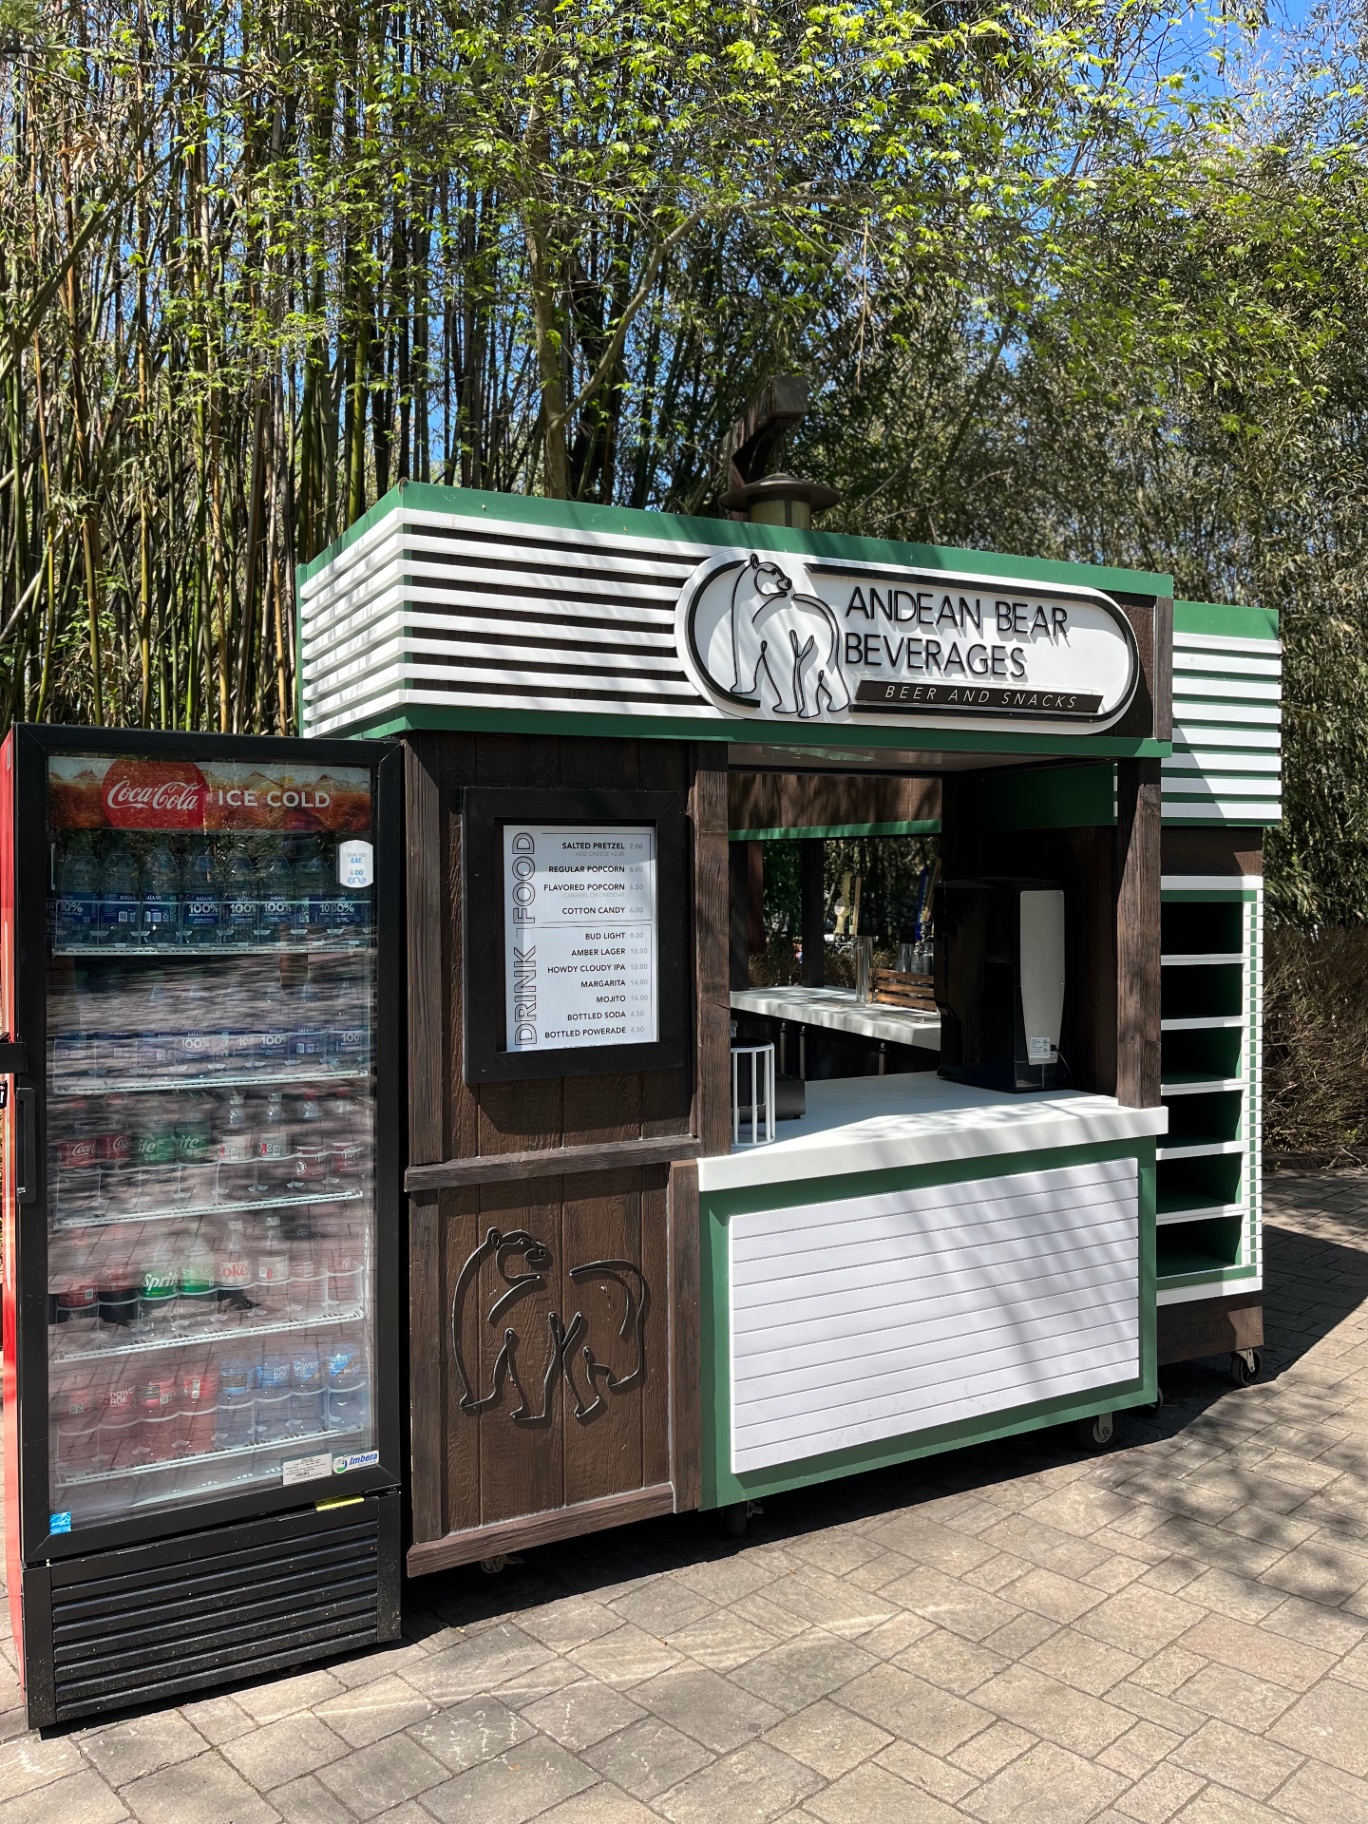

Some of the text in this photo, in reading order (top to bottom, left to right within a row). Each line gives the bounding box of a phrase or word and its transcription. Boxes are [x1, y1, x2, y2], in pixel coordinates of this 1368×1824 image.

[845, 586, 1068, 637] ANDEAN BEAR
[845, 632, 1025, 678] BEVERAGES
[885, 685, 1077, 709] BEER AND SNACKS
[107, 780, 204, 810] Coca-Cola
[218, 789, 331, 808] ICE COLD
[512, 832, 536, 924] FOOD
[189, 903, 218, 914] 100%
[264, 902, 292, 912] 100%
[580, 964, 612, 972] CLOUDY
[580, 980, 626, 988] MARGARITA
[514, 945, 538, 1046] DRINK
[596, 995, 626, 1003] MOJITO
[567, 1012, 602, 1020] BOTTLED
[341, 1032, 360, 1042] 100
[544, 1030, 580, 1038] BOTTLED
[582, 1026, 626, 1036] POWERADE
[222, 1264, 248, 1278] oke
[349, 1452, 378, 1466] Imbera
